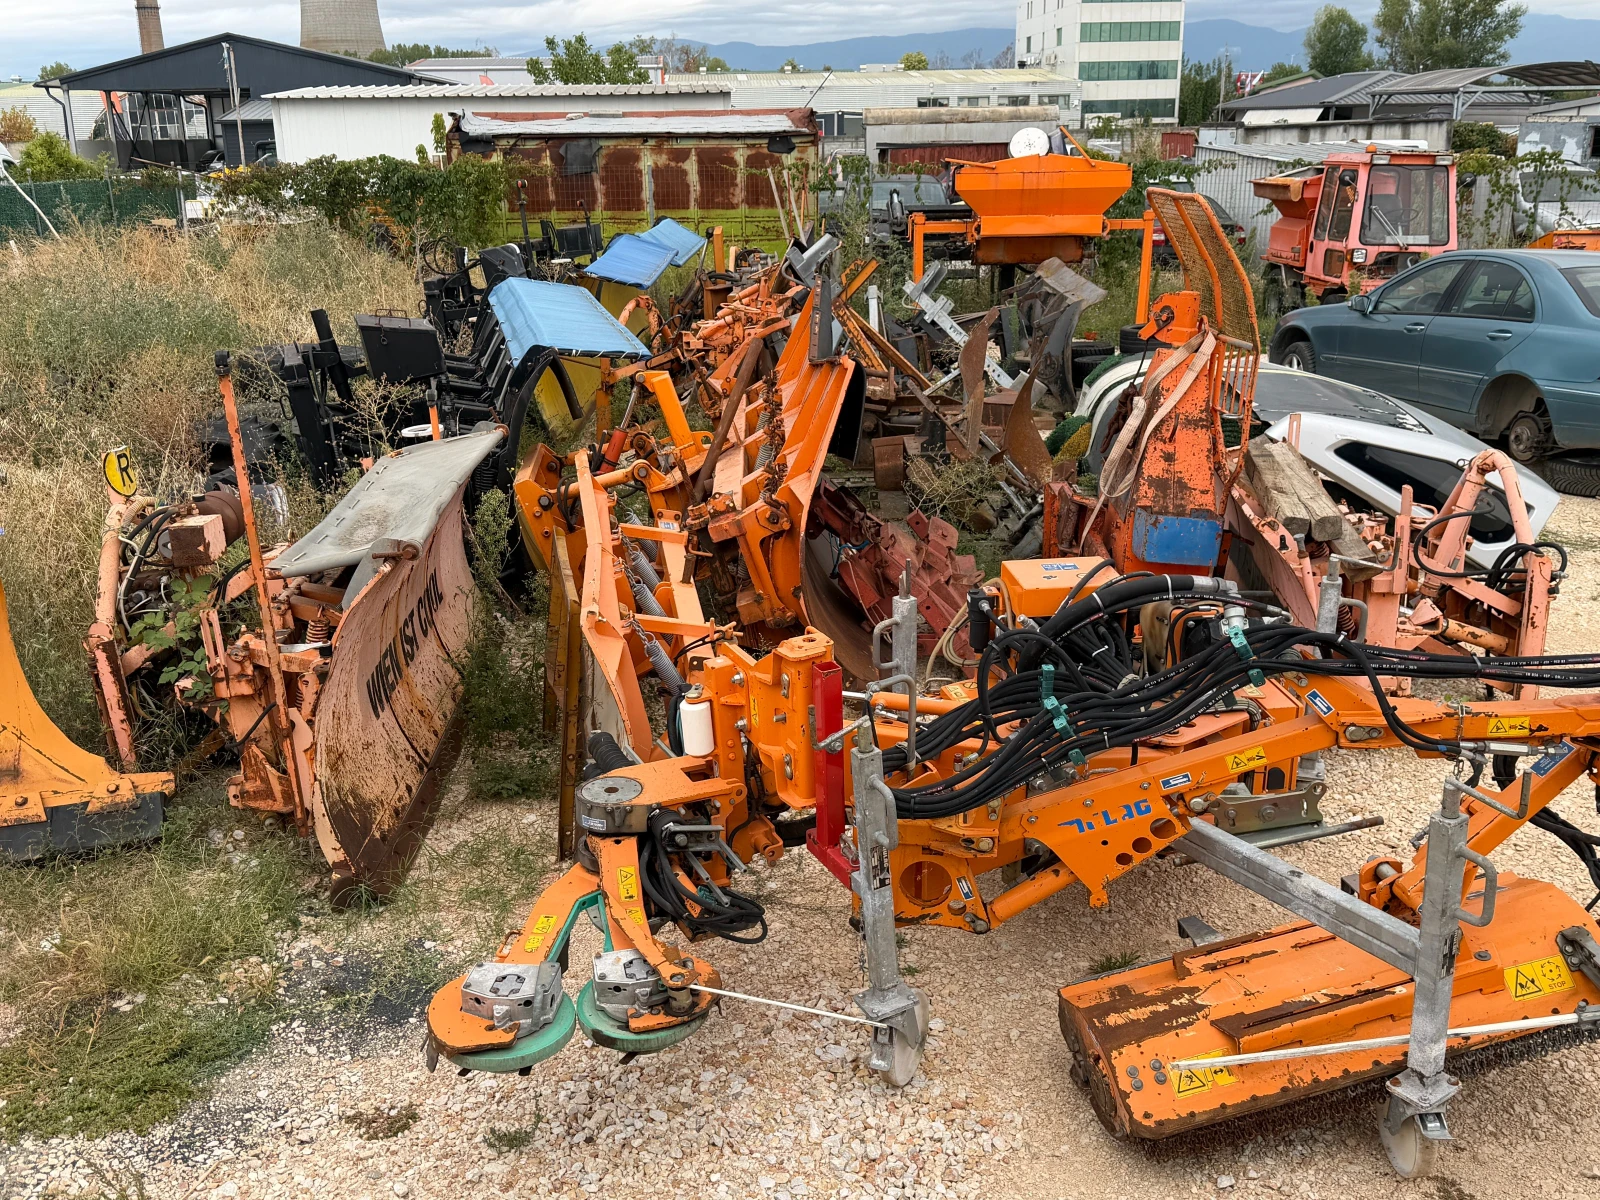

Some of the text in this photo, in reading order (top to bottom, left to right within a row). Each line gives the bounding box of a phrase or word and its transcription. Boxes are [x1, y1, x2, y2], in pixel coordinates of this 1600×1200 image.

[117, 452, 134, 487] R
[399, 607, 419, 668] IST
[417, 567, 444, 638] COOL
[1548, 980, 1567, 991] STOP
